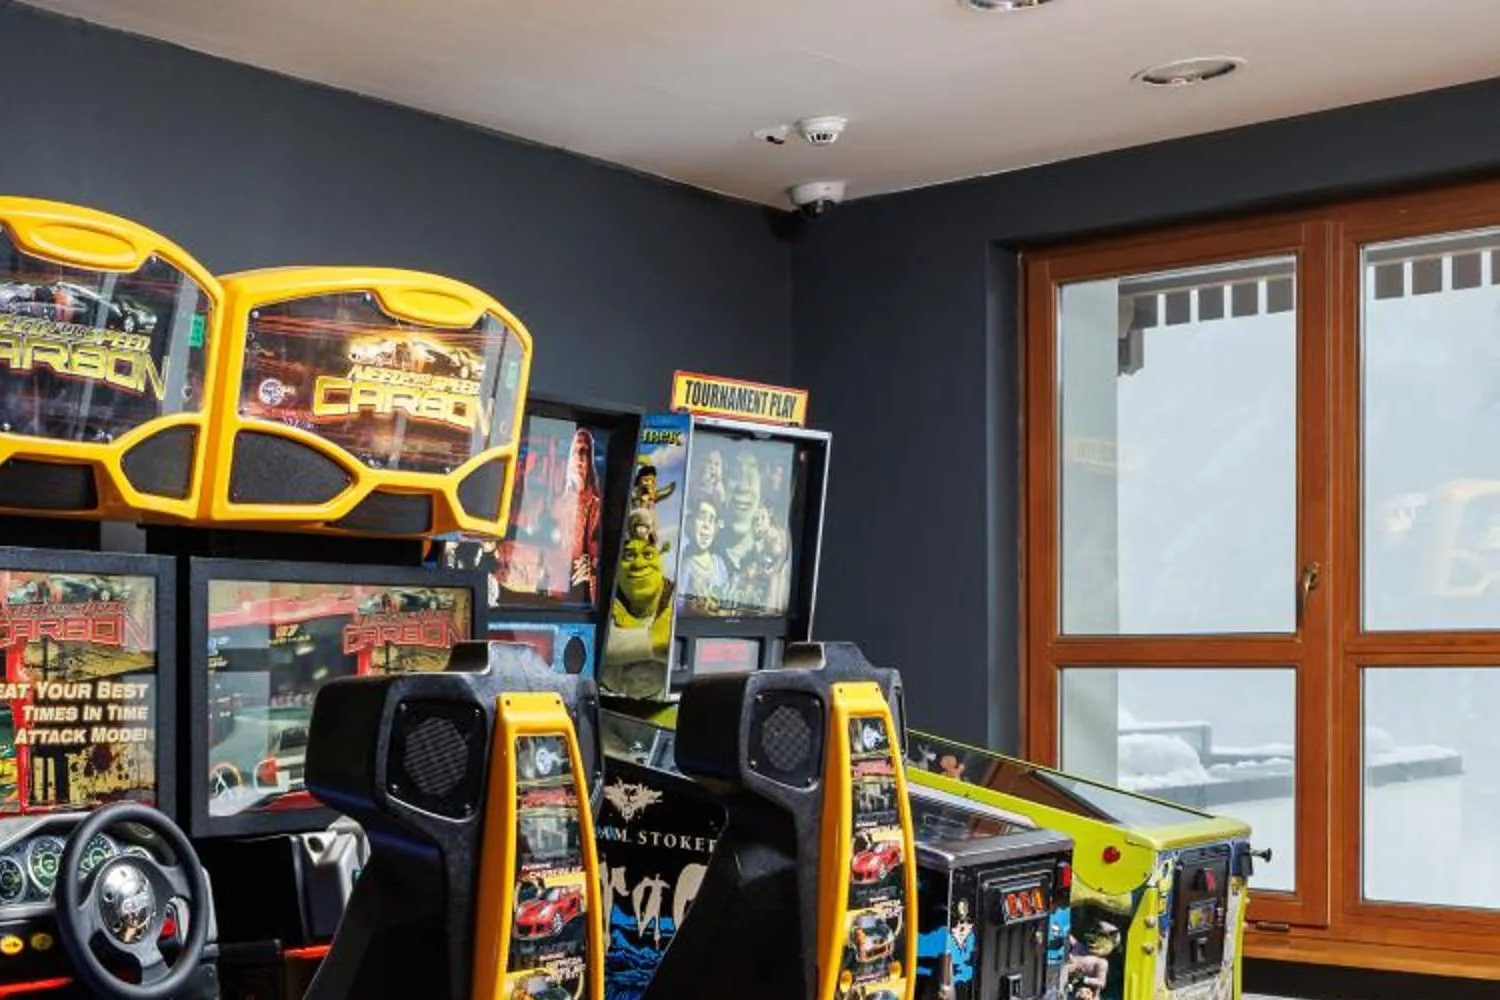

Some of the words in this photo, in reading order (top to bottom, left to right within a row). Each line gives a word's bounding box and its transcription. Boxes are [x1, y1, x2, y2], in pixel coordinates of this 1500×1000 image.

[88, 326, 150, 350] SPEED
[314, 376, 494, 437] CARBON
[685, 380, 768, 413] TOURNAMENT
[769, 393, 798, 418] PLAY
[342, 620, 470, 654] CARBON
[36, 681, 92, 699] YOUR
[97, 681, 148, 699] BEST
[23, 705, 79, 721] TIMES
[84, 705, 102, 721] IN
[108, 705, 148, 721] TIME
[15, 728, 87, 744] ATTACK
